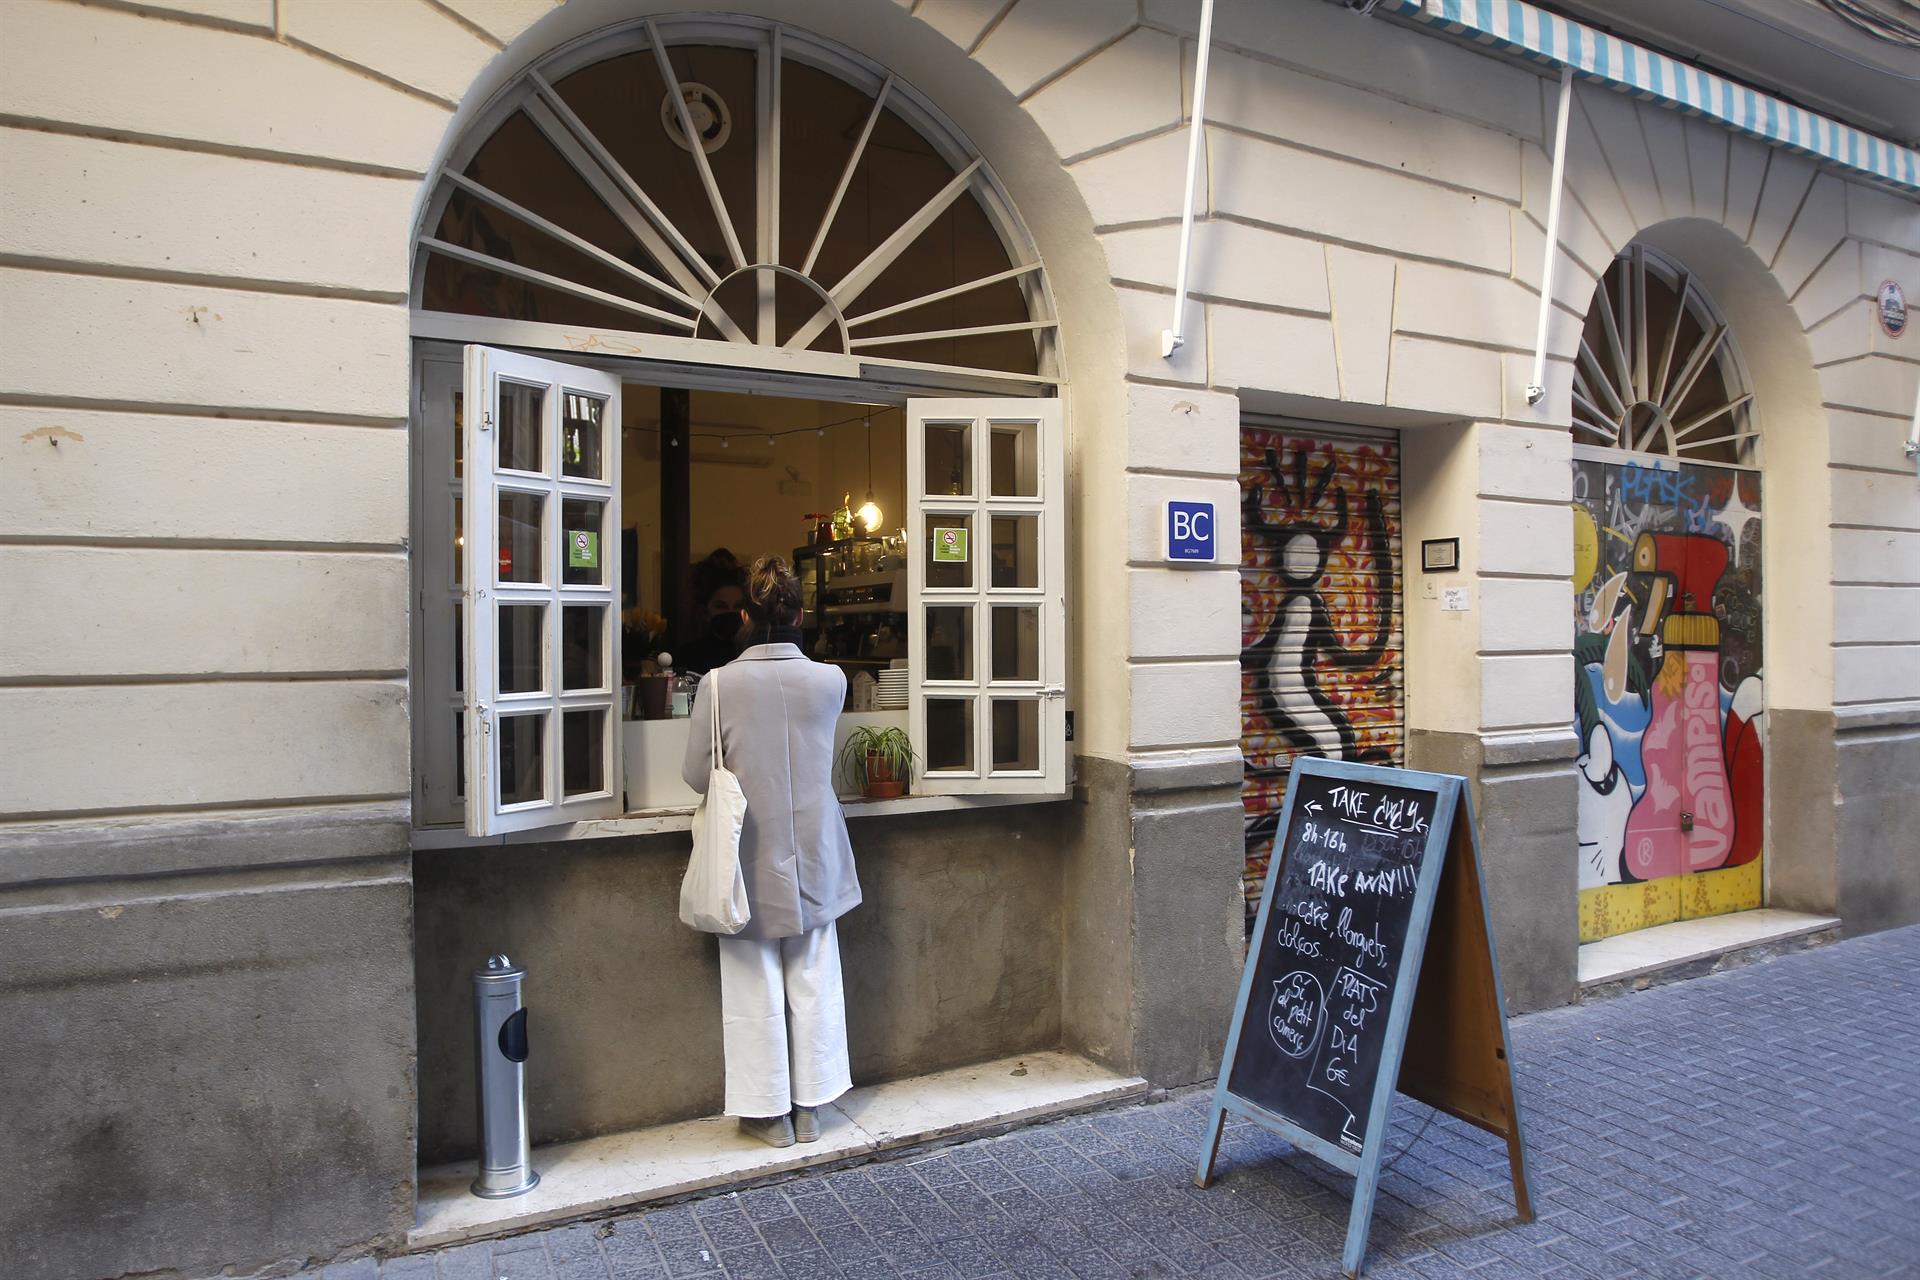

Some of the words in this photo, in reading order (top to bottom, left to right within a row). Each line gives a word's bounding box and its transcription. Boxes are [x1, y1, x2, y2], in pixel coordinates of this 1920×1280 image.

[1174, 511, 1209, 541] BC
[1328, 786, 1370, 818] TAKE
[1302, 822, 1347, 853] 8h-16h
[1287, 1000, 1314, 1027] petit
[1343, 1003, 1366, 1031] del
[1326, 1057, 1350, 1087] 6€
